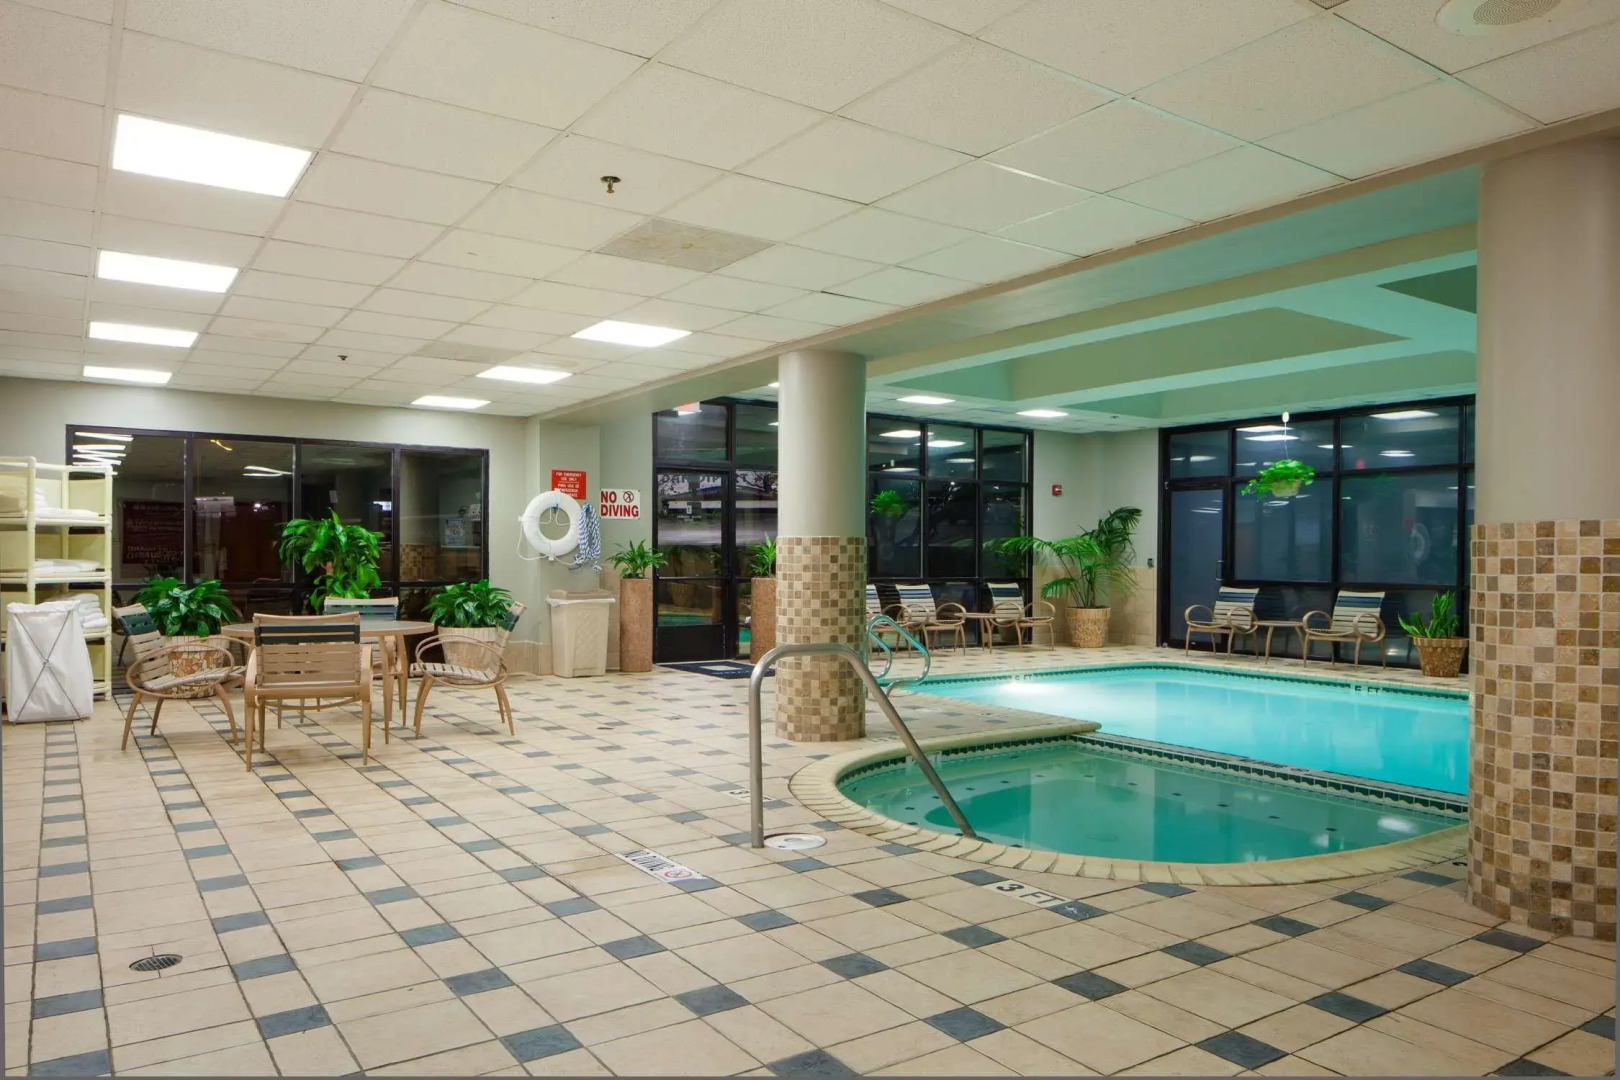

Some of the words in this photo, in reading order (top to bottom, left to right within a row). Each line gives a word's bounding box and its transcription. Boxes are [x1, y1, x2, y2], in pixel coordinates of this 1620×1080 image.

[600, 491, 617, 503] NO
[600, 504, 639, 517] DIVING
[996, 883, 1025, 892] 3
[1018, 890, 1066, 904] FT
